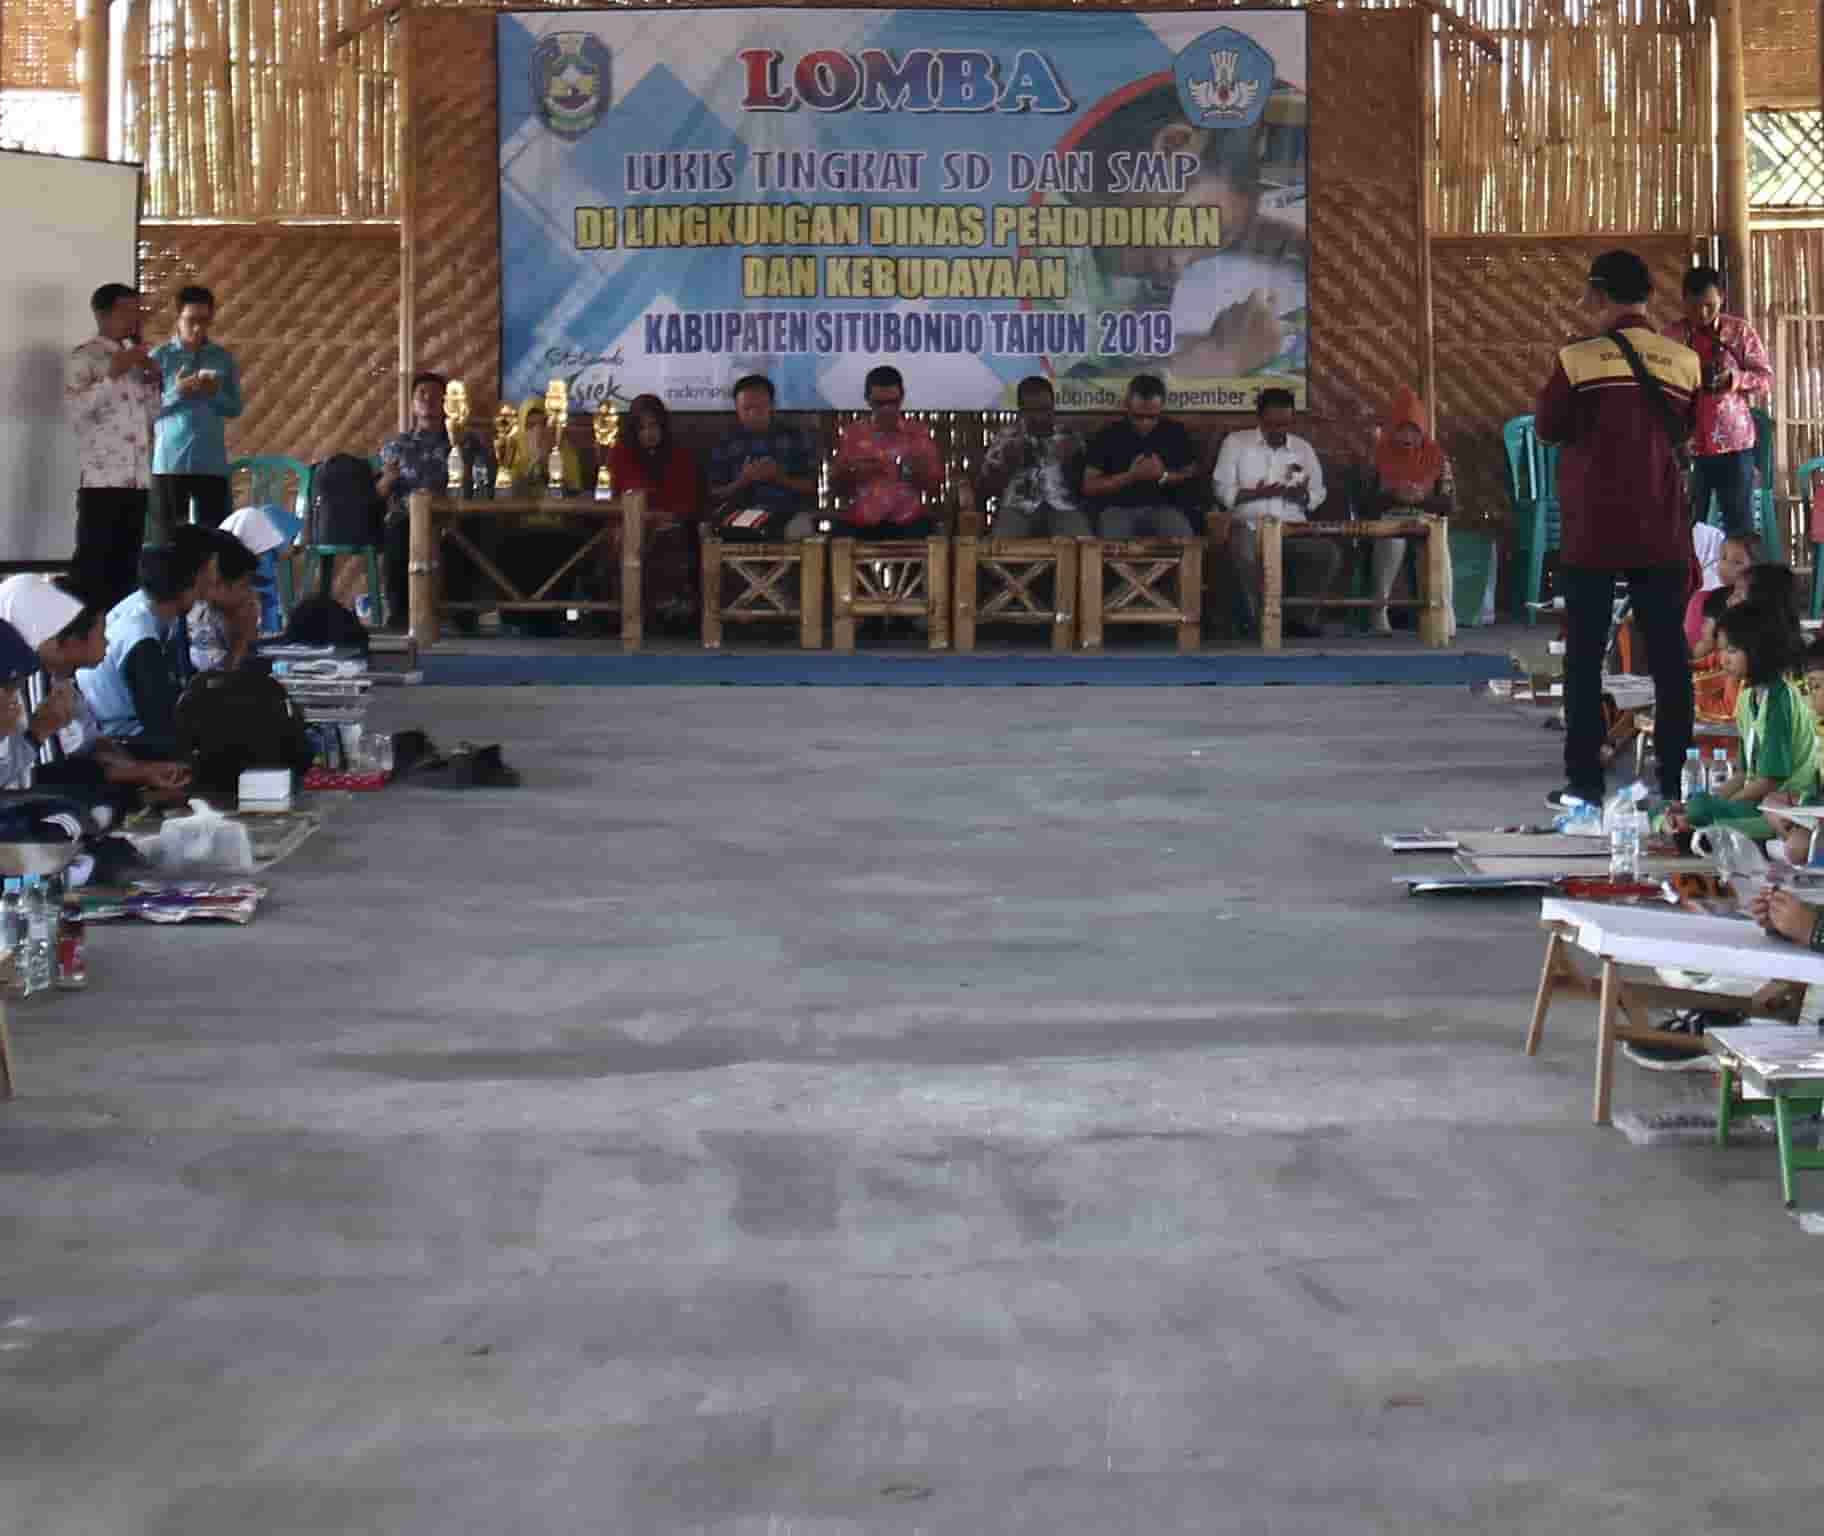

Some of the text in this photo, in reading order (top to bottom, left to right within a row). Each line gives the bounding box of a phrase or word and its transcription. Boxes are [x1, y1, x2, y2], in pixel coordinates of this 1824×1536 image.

[736, 49, 1075, 113] LOMBA
[625, 151, 1200, 192] LUKIS TINGKAT SD DAN SMP
[575, 203, 1222, 249] DI LINGKUNGAN DINAS PENDIDIKAN
[742, 255, 1067, 299] DAN KEBUDAYAAN
[644, 311, 1175, 356] KABUPATEN SITUBONDO TAHUN 2019
[1167, 387, 1247, 407] opember
